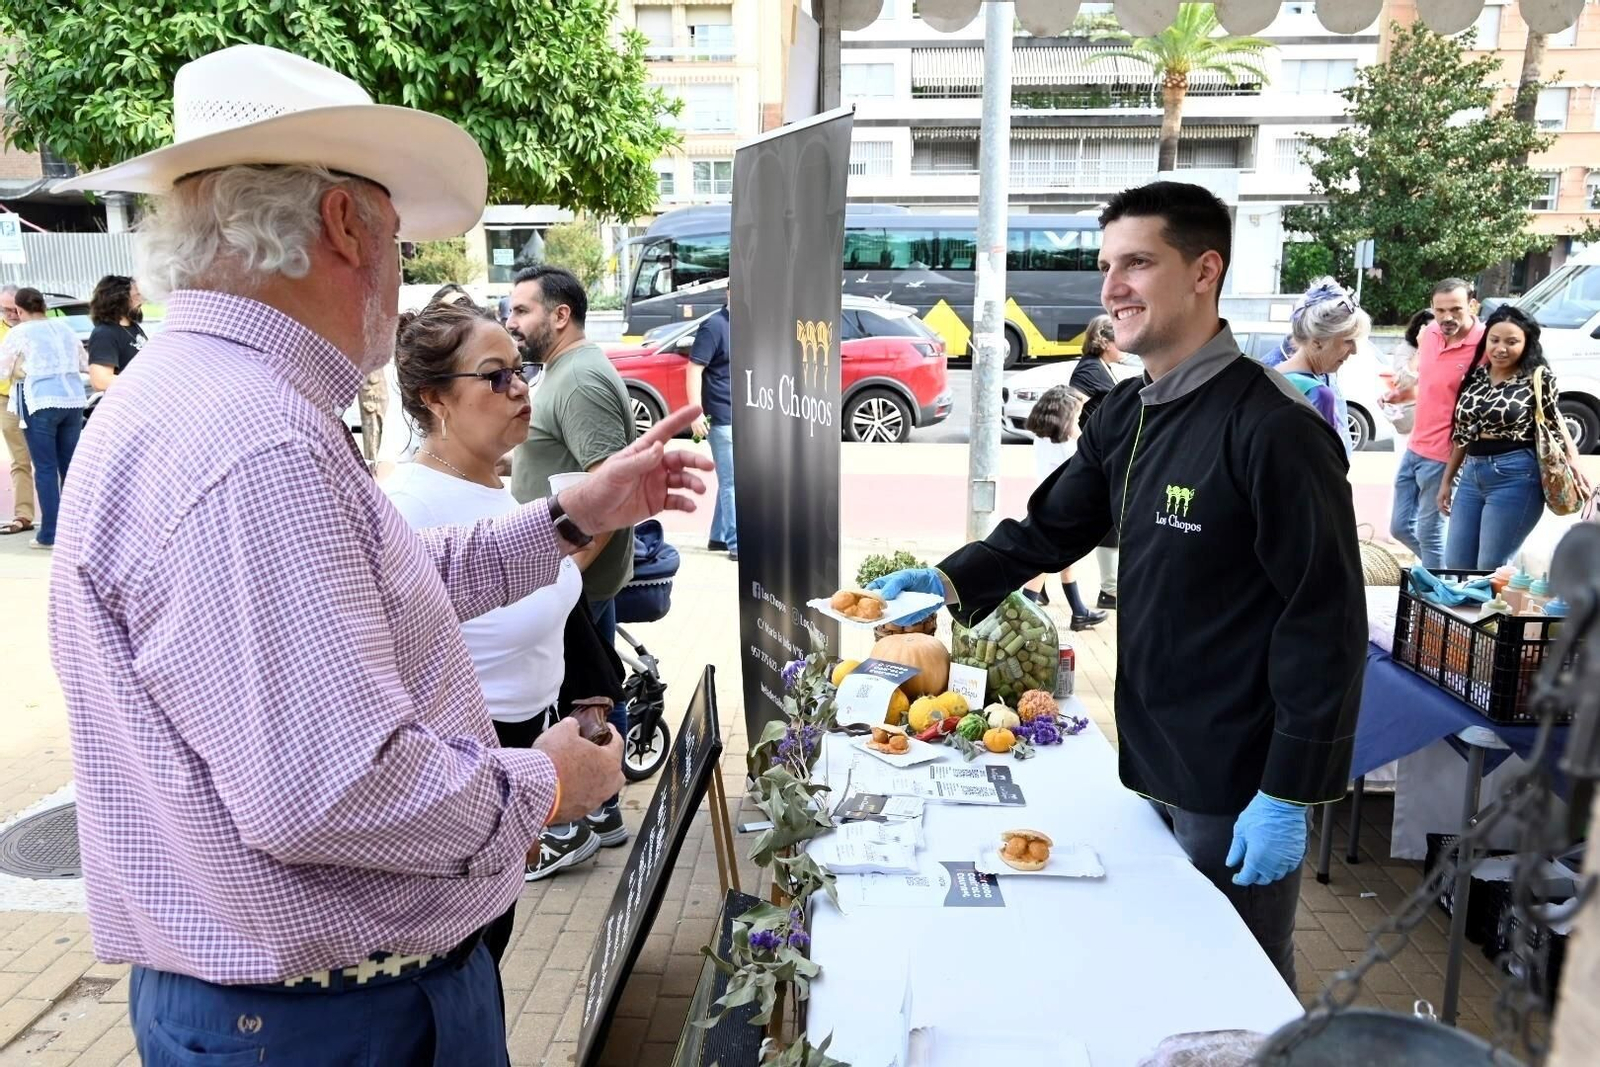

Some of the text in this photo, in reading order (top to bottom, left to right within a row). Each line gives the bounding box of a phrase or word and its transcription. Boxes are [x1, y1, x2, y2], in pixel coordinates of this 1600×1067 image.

[745, 370, 832, 437] Los Chopos
[1156, 512, 1201, 533] Los Chopos
[761, 587, 770, 601] Los
